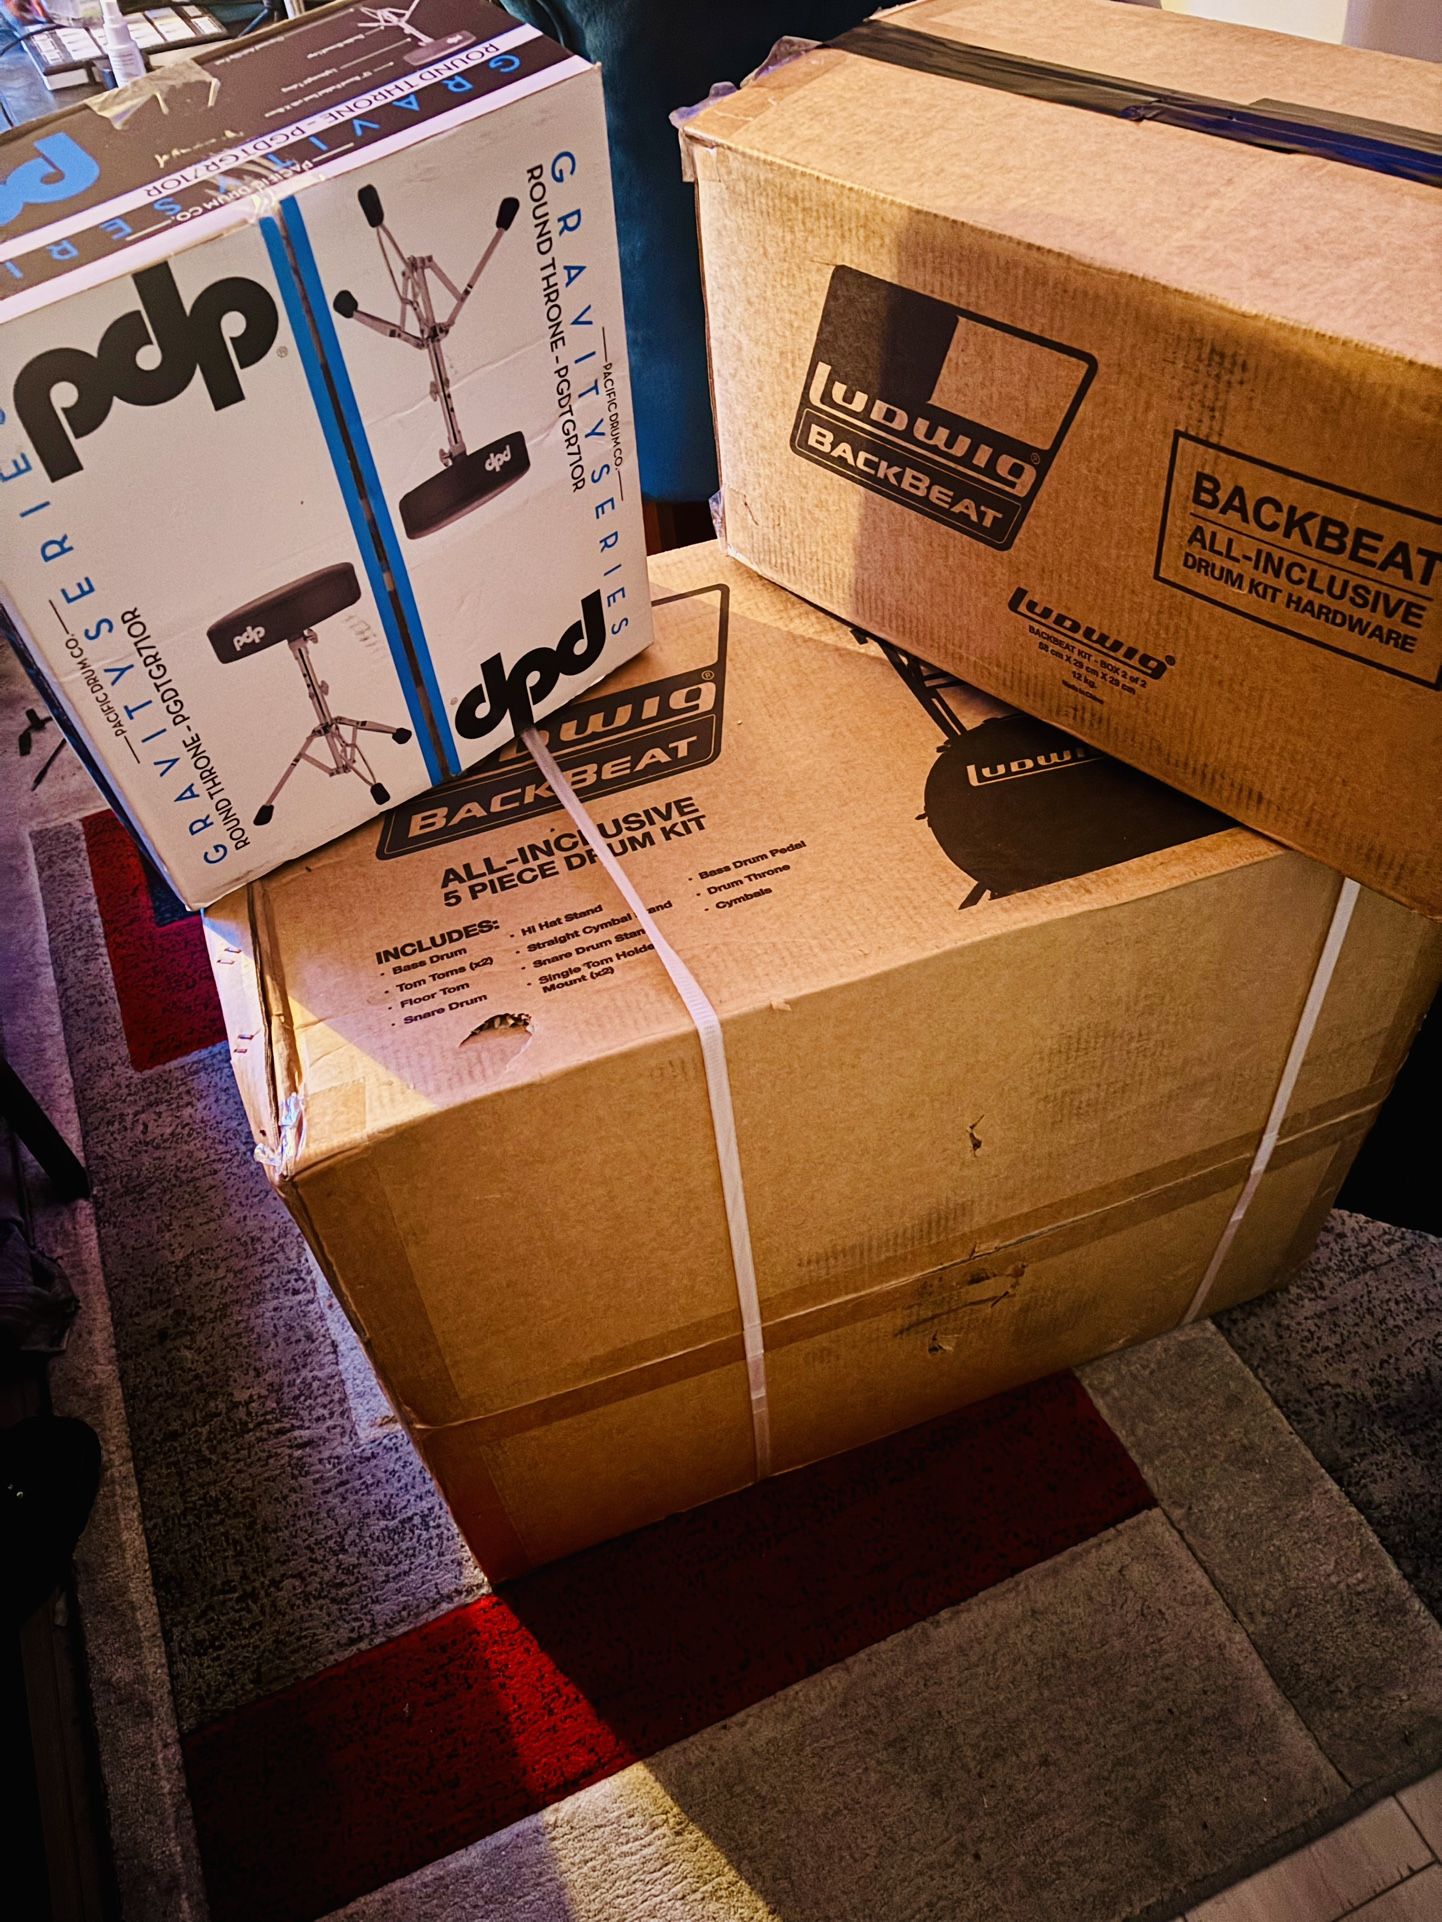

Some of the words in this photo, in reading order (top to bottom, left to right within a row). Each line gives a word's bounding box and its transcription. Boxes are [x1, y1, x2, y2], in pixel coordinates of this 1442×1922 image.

[419, 43, 500, 83] ROUND
[321, 80, 418, 122] THRONE
[214, 54, 521, 194] GRAVITY
[203, 186, 252, 211] DRUM
[526, 163, 553, 256] ROUND
[540, 257, 566, 352] THRONE
[13, 261, 279, 483] pdp
[603, 362, 617, 413] PACIFIC
[551, 151, 606, 438] GRAVITY
[591, 463, 629, 636] SERIES
[609, 412, 622, 449] DRUM
[485, 444, 511, 472] pdp
[613, 448, 624, 471] CO.
[808, 423, 1003, 529] BACKBEAT
[0, 408, 113, 641] SERIE
[1192, 471, 1442, 587] BACKBEAT
[1187, 525, 1427, 629] ALL-INCLUSIVE
[1183, 551, 1244, 592] DRUM
[1249, 575, 1283, 604] KIT
[1286, 592, 1418, 654] HARDWARE
[65, 633, 84, 659] CO.
[233, 625, 265, 651] pdp
[1028, 625, 1078, 654] BACKBEAT
[1077, 648, 1094, 663] KIT
[1100, 660, 1121, 677] BOX
[1121, 669, 1128, 680] 2
[1129, 673, 1141, 685] of
[1139, 678, 1148, 689] 2
[77, 657, 103, 694] DRUM
[1050, 646, 1064, 661] cm
[1085, 663, 1099, 677] cm
[1121, 681, 1136, 695] cm
[1071, 670, 1083, 682] 12
[95, 692, 126, 737] PACIFIC
[103, 663, 228, 865] GRAVITY
[182, 732, 224, 800] THRONE
[408, 736, 697, 838] BACKBEAT
[214, 797, 250, 851] ROUND
[443, 889, 462, 907] 5
[468, 860, 560, 901] PIECE
[660, 814, 707, 842] KIT
[698, 865, 732, 880] Bass
[732, 853, 769, 869] Drum
[769, 840, 807, 857] Pedal
[706, 879, 744, 895] Drum
[744, 864, 791, 882] Throne
[538, 916, 563, 931] Hat
[564, 904, 603, 923] Stand
[715, 887, 773, 910] Cymbals
[376, 919, 500, 965] INCLUDES:
[527, 929, 581, 953] Straight
[582, 912, 633, 935] Cymbal
[635, 900, 673, 919] and
[393, 959, 427, 976] Bass
[429, 947, 468, 964] Drum
[532, 951, 573, 969] Snare
[575, 938, 613, 955] Drum
[615, 927, 647, 943] Stan
[538, 965, 582, 985] Single
[583, 956, 614, 970] Tom
[615, 943, 656, 961] Holde
[396, 978, 427, 993] Tom
[429, 965, 467, 983] Toms
[468, 956, 494, 972] (x2)
[400, 991, 438, 1009] Floor
[439, 981, 470, 997] Tom
[542, 974, 588, 994] Mount
[590, 966, 615, 980] (x2)
[403, 1006, 446, 1025] Snare
[448, 993, 488, 1012] Drum
